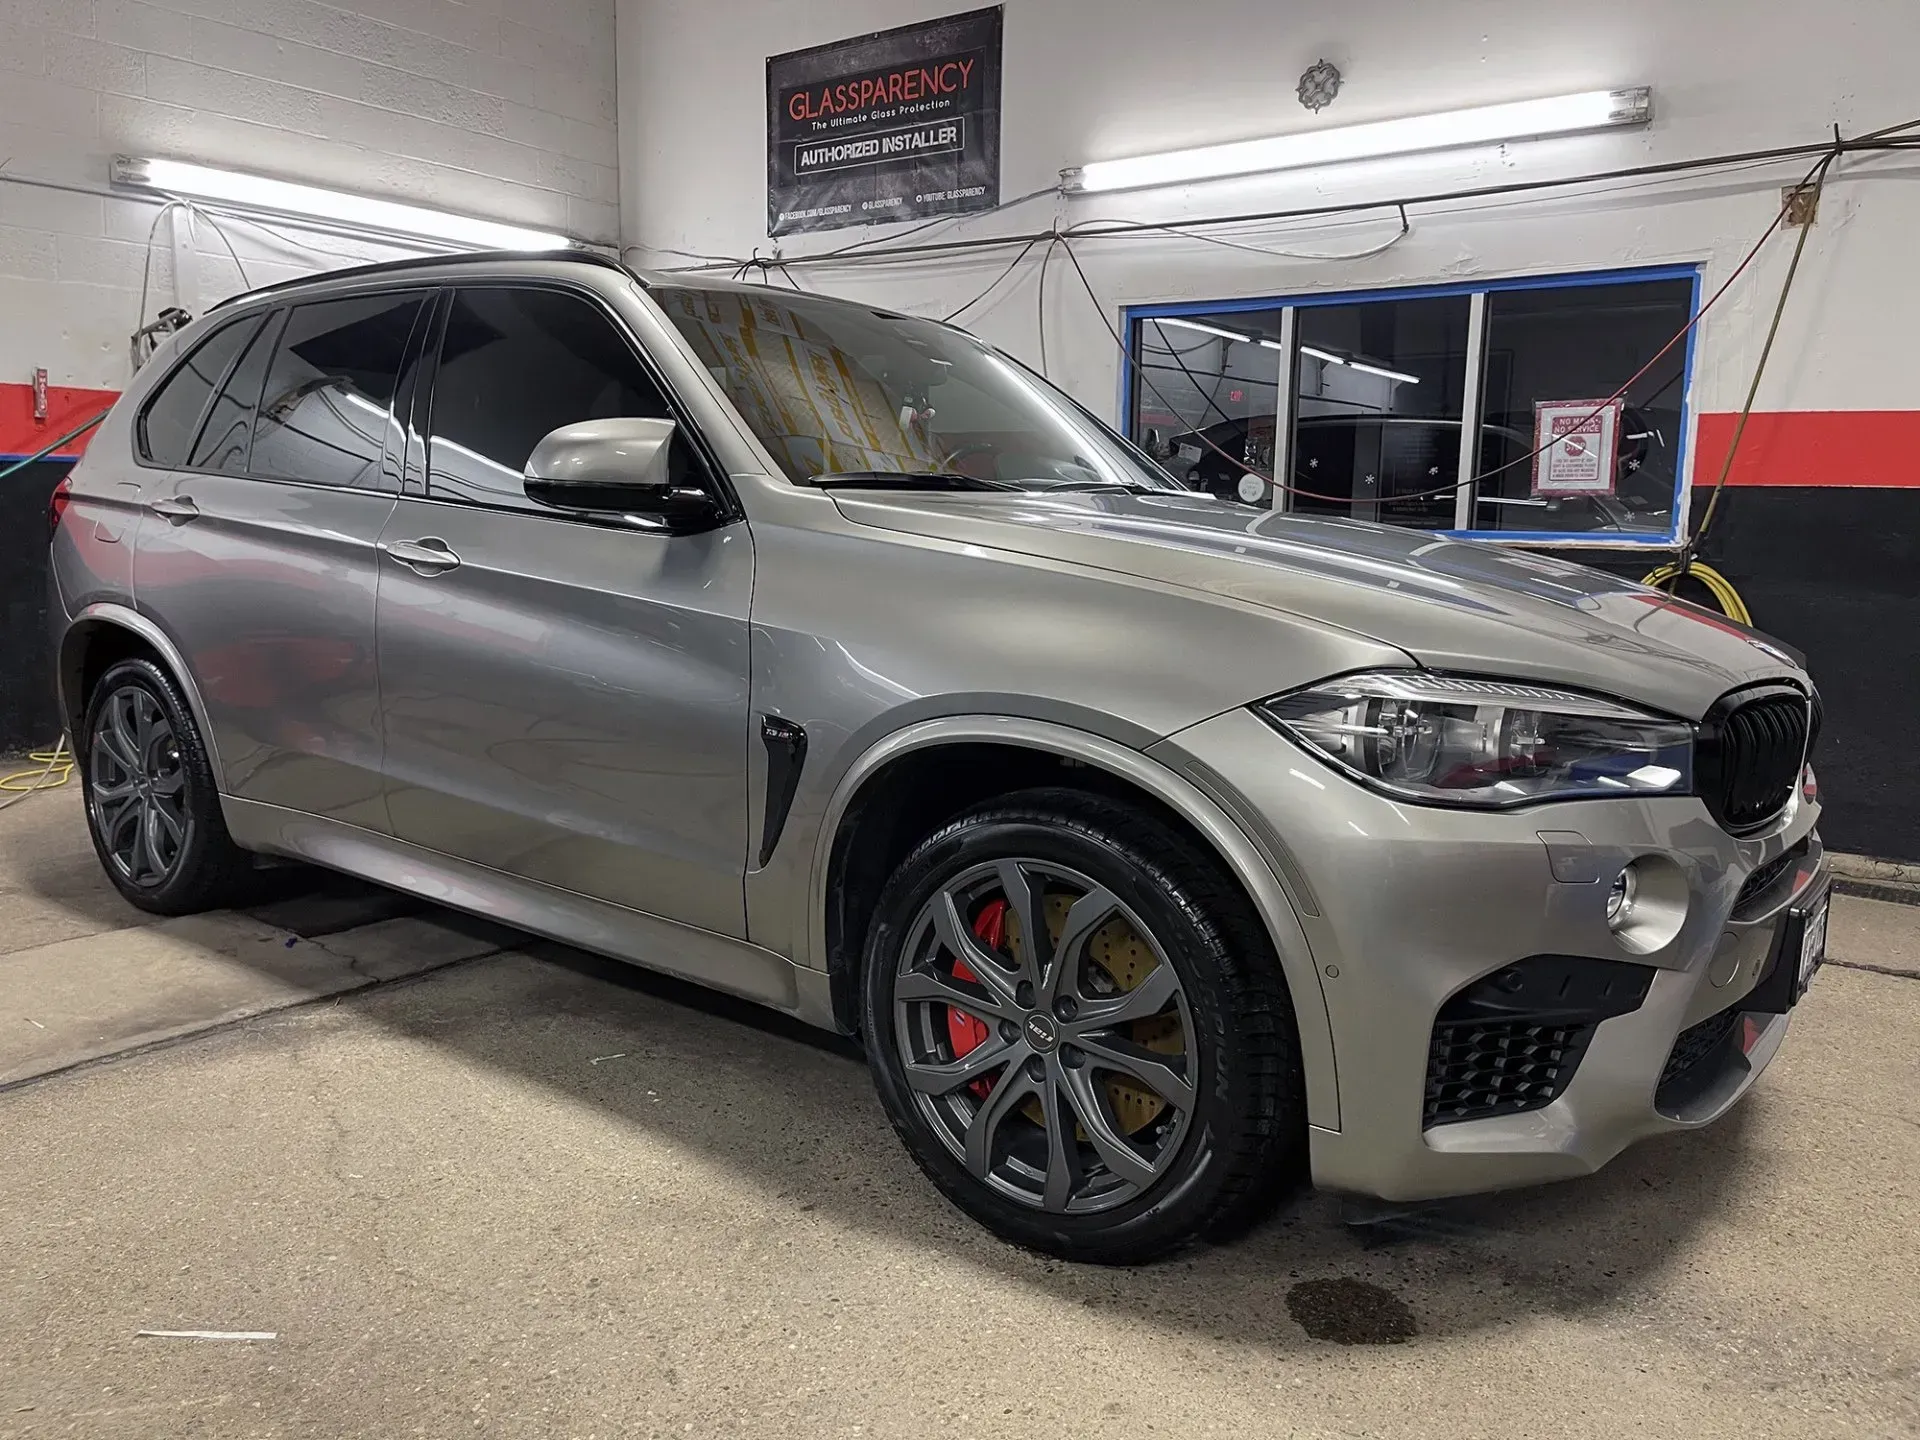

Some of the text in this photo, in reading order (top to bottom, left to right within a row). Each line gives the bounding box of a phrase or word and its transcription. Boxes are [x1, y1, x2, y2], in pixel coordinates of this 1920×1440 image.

[788, 58, 974, 121] GLASSPARENCY
[811, 99, 951, 131] The Ultimate Glass Protection
[801, 126, 957, 167] AUTHORIZED INSTALLER
[1554, 426, 1566, 434] NO
[1559, 418, 1571, 426] NO
